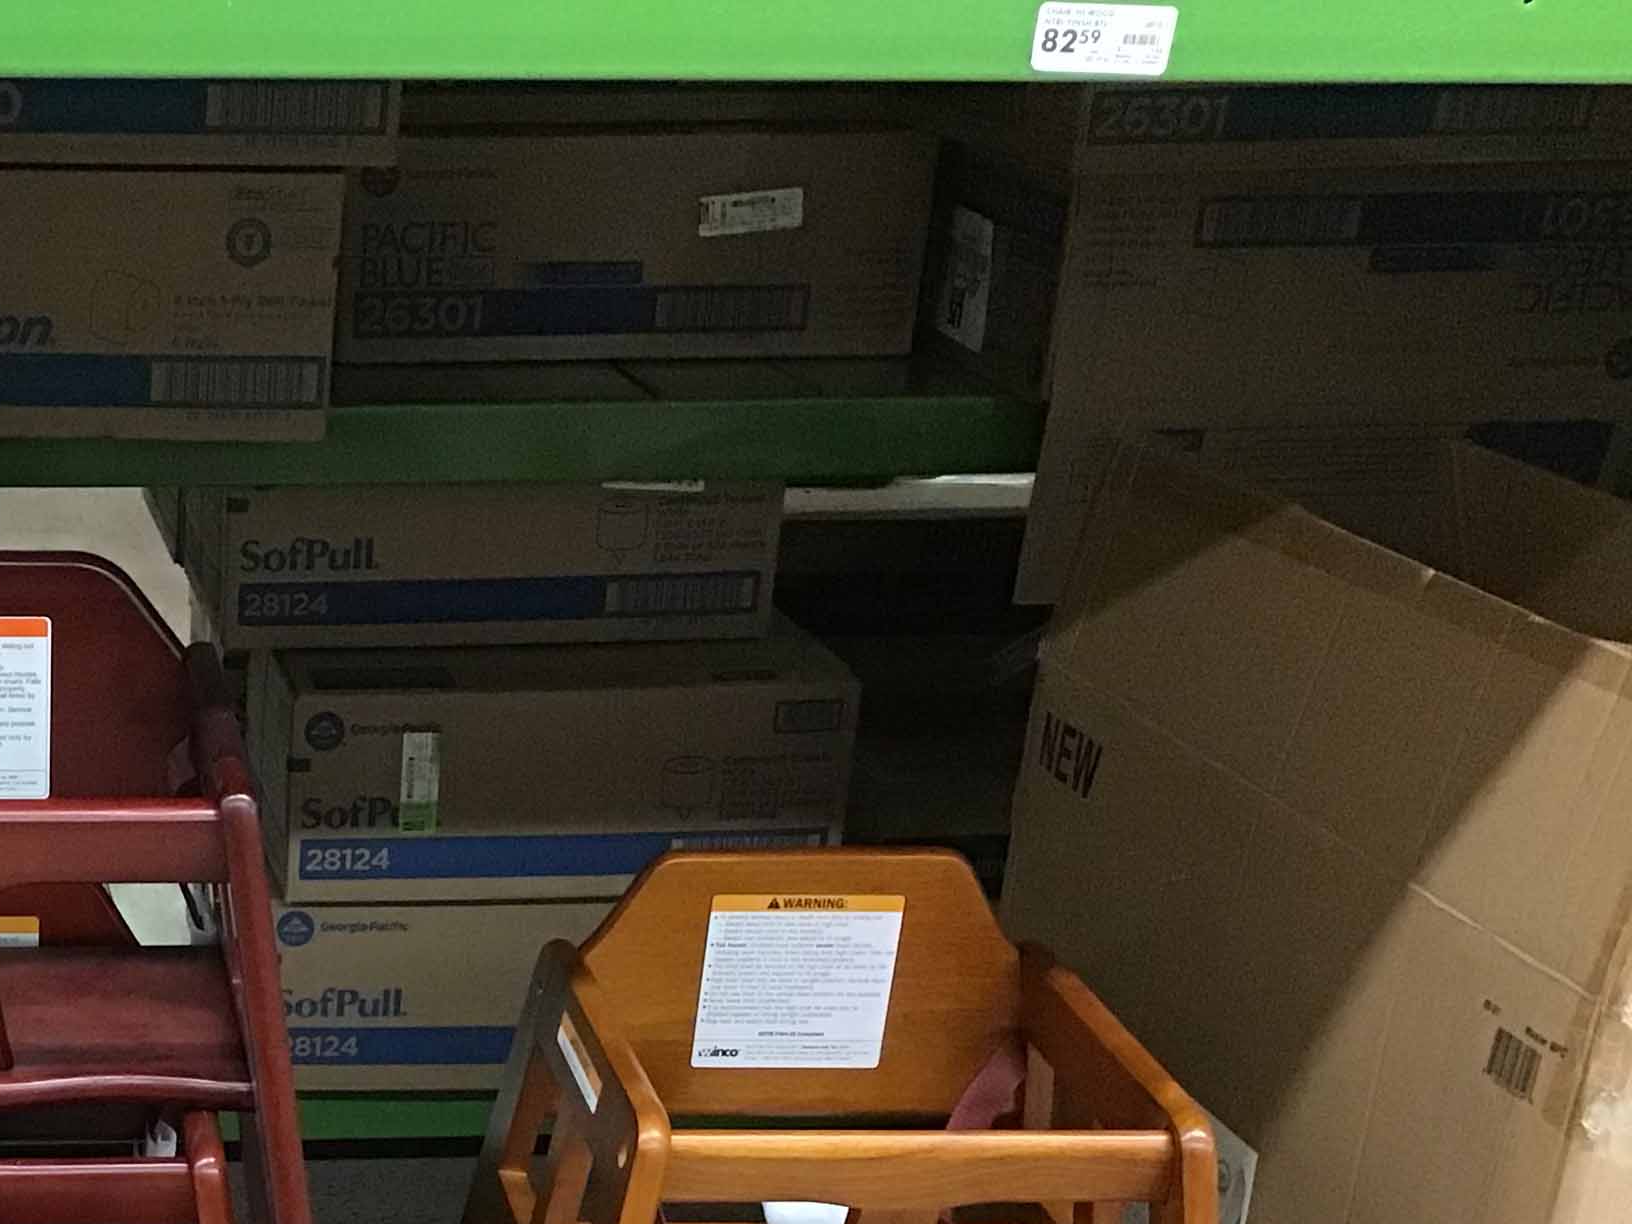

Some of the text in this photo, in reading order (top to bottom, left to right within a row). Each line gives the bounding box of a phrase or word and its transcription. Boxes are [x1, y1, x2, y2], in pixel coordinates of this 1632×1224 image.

[361, 220, 497, 256] PACIFIC
[360, 257, 443, 288] BLUE
[359, 296, 484, 333] 26301
[240, 538, 377, 572] SofPull
[243, 592, 329, 618] 28124
[1039, 711, 1103, 799] NEW
[306, 848, 389, 871] 28124
[289, 1034, 359, 1057] 8124
